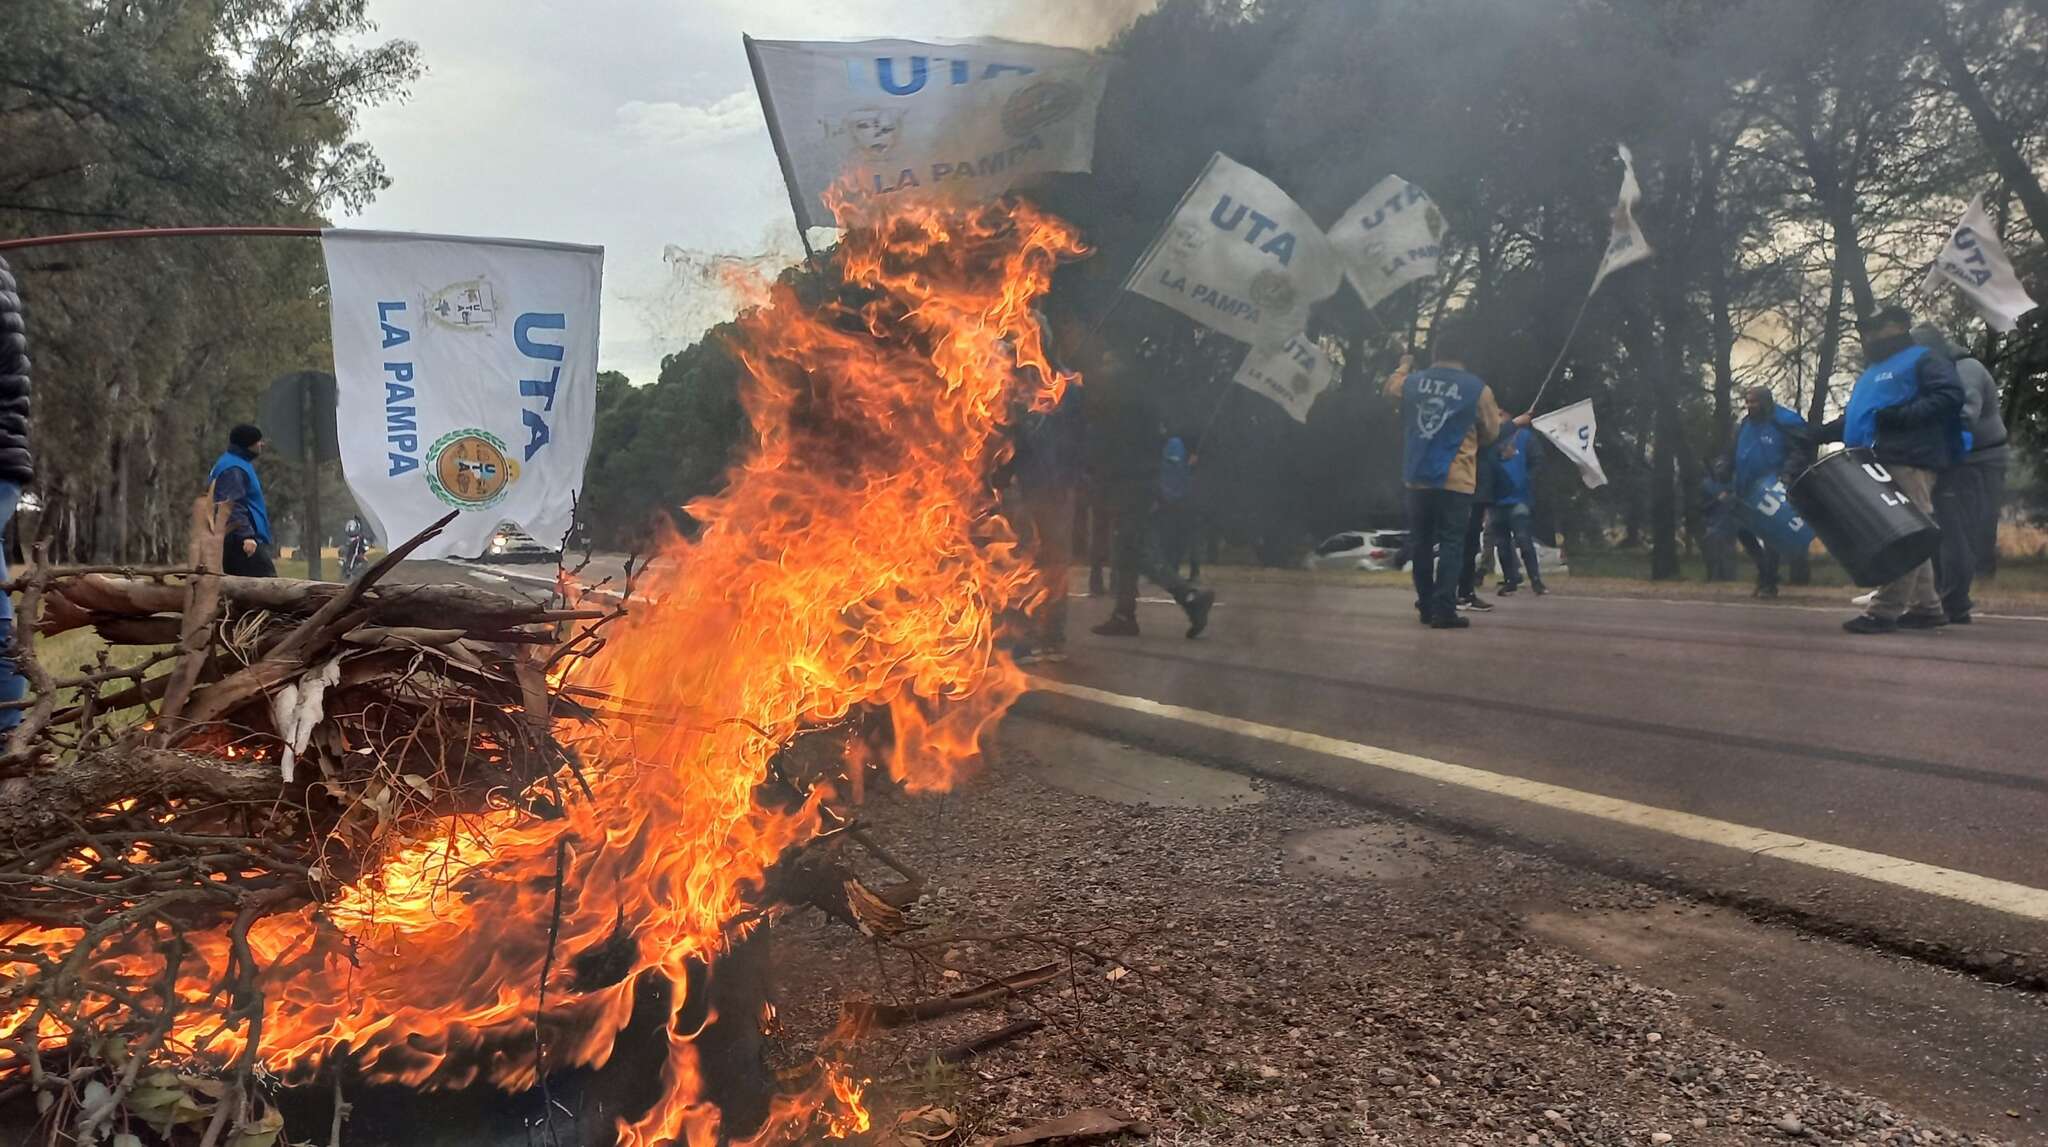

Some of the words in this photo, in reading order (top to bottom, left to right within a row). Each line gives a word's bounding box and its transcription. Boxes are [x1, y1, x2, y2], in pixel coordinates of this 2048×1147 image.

[873, 168, 920, 194] LA
[931, 135, 1042, 182] PAMPA
[1209, 195, 1297, 266] UTA
[1954, 227, 1992, 287] UTA
[377, 301, 411, 348] LA
[457, 304, 481, 312] UTA
[1160, 270, 1185, 292] LA
[1190, 284, 1260, 324] PAMPA
[513, 312, 566, 463] UTA
[1418, 378, 1462, 400] U.T.A.
[383, 362, 419, 477] PAMPA
[459, 462, 496, 473] UTA
